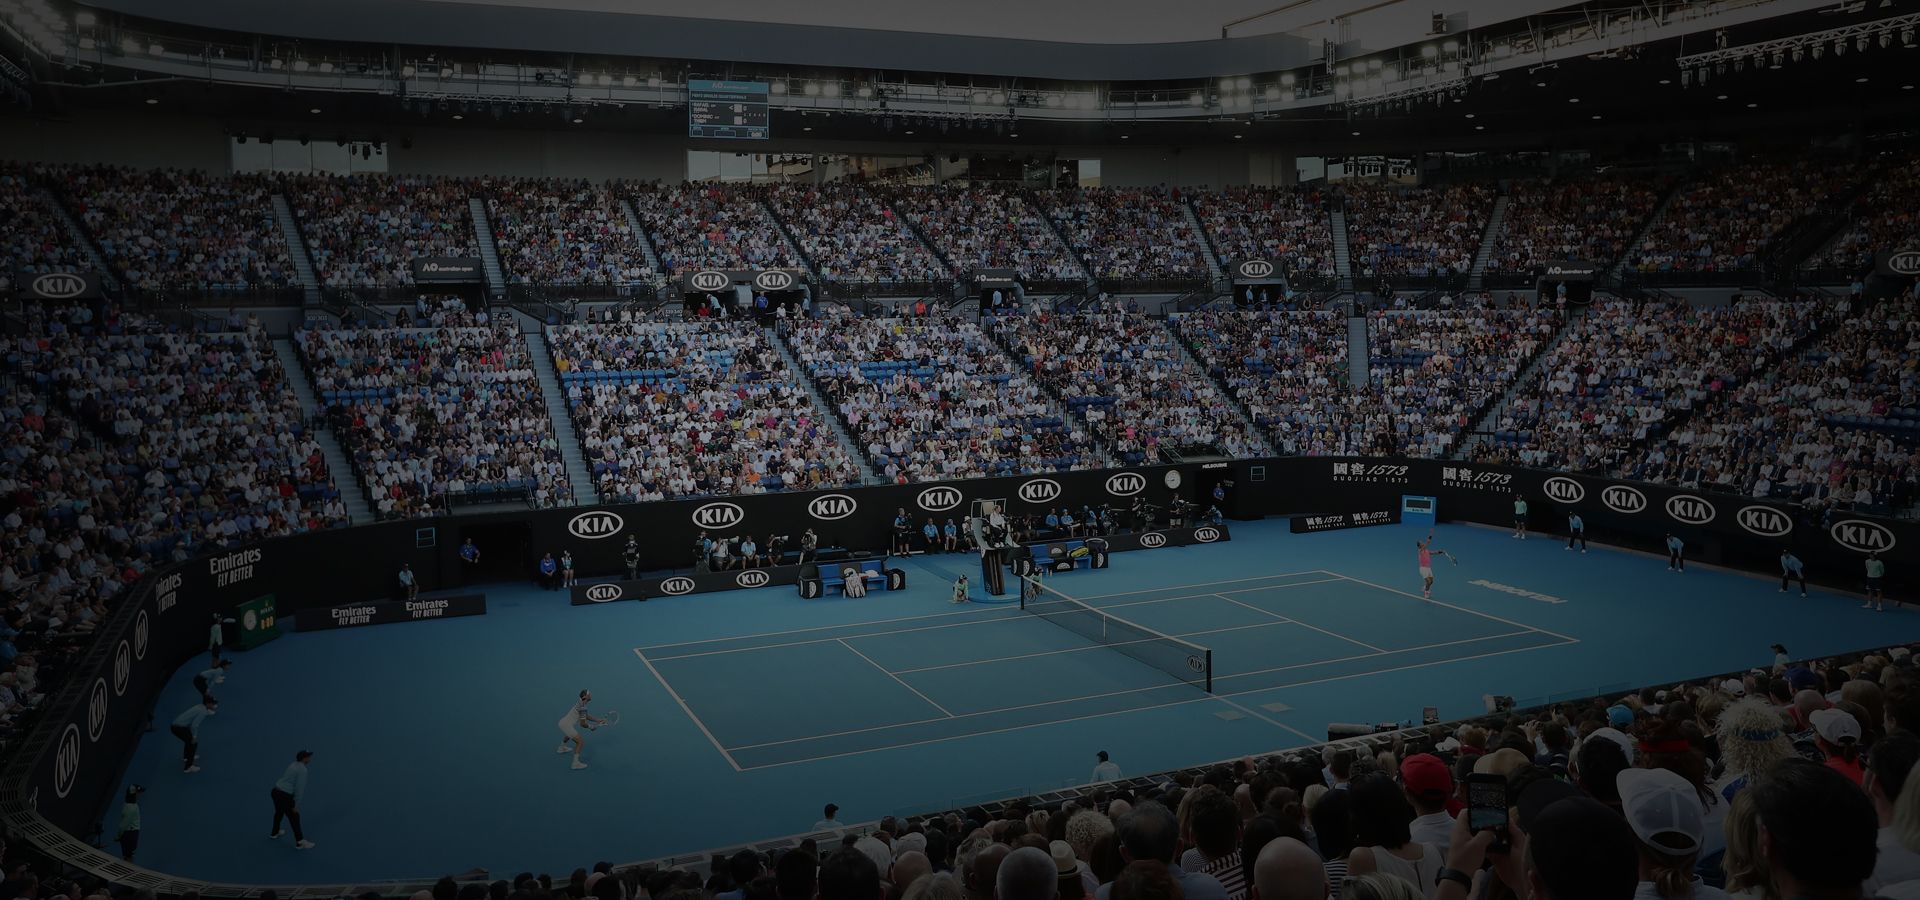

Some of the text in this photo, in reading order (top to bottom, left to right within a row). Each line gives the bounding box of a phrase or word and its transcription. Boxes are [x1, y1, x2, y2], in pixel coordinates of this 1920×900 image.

[422, 262, 439, 272] AO
[1244, 263, 1269, 275] KIA
[1547, 266, 1562, 275] AO
[41, 278, 79, 293] KIA
[697, 274, 723, 287] KIA
[762, 274, 787, 286] KIA
[1025, 483, 1055, 499] KIA
[1112, 476, 1140, 492] KIA
[1549, 481, 1578, 500] KIA
[816, 499, 850, 515] KIA
[924, 491, 956, 507] KIA
[1608, 489, 1640, 509] KIA
[700, 507, 736, 524] KIA
[1673, 499, 1708, 520] KIA
[577, 516, 615, 534] KIA
[1745, 510, 1784, 532] KIA
[1143, 535, 1162, 545] KIA
[1197, 530, 1216, 540] KIA
[1841, 524, 1885, 548] KIA
[209, 548, 262, 575] Emirates
[217, 564, 254, 588] FLY BETTER
[741, 573, 763, 585] KIA
[592, 587, 615, 599] KIA
[666, 580, 690, 592] KIA
[331, 606, 376, 618] Emirates
[405, 600, 449, 611] Emirates
[92, 686, 105, 734] KIA
[59, 734, 77, 789] KIA
